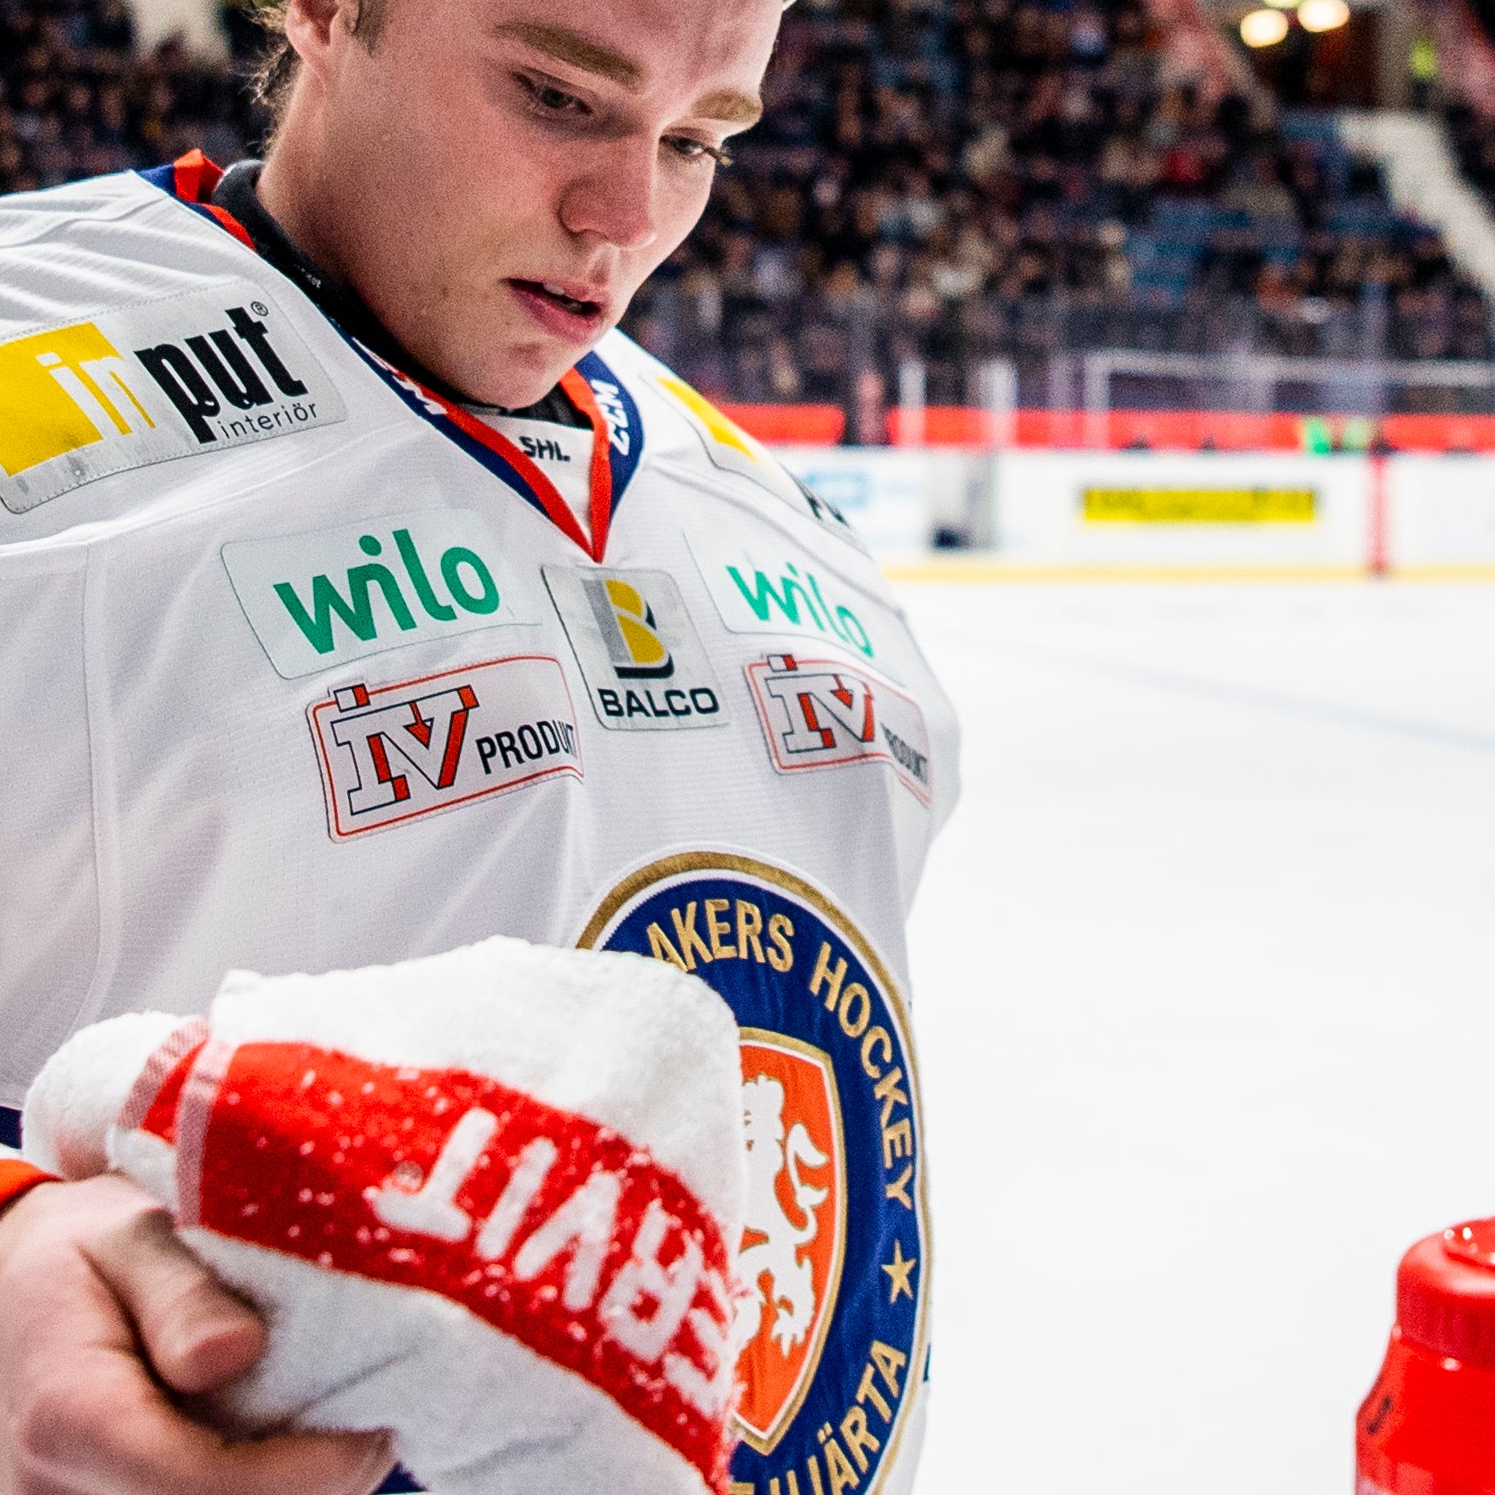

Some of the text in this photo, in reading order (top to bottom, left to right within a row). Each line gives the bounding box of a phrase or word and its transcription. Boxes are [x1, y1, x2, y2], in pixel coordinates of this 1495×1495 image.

[35, 306, 309, 445] input
[220, 401, 319, 441] interiör
[273, 528, 502, 656] wilo
[724, 561, 875, 660] wilo
[330, 683, 480, 816] IV
[596, 686, 721, 718] BALCO
[809, 940, 916, 1211] HOCKEY
